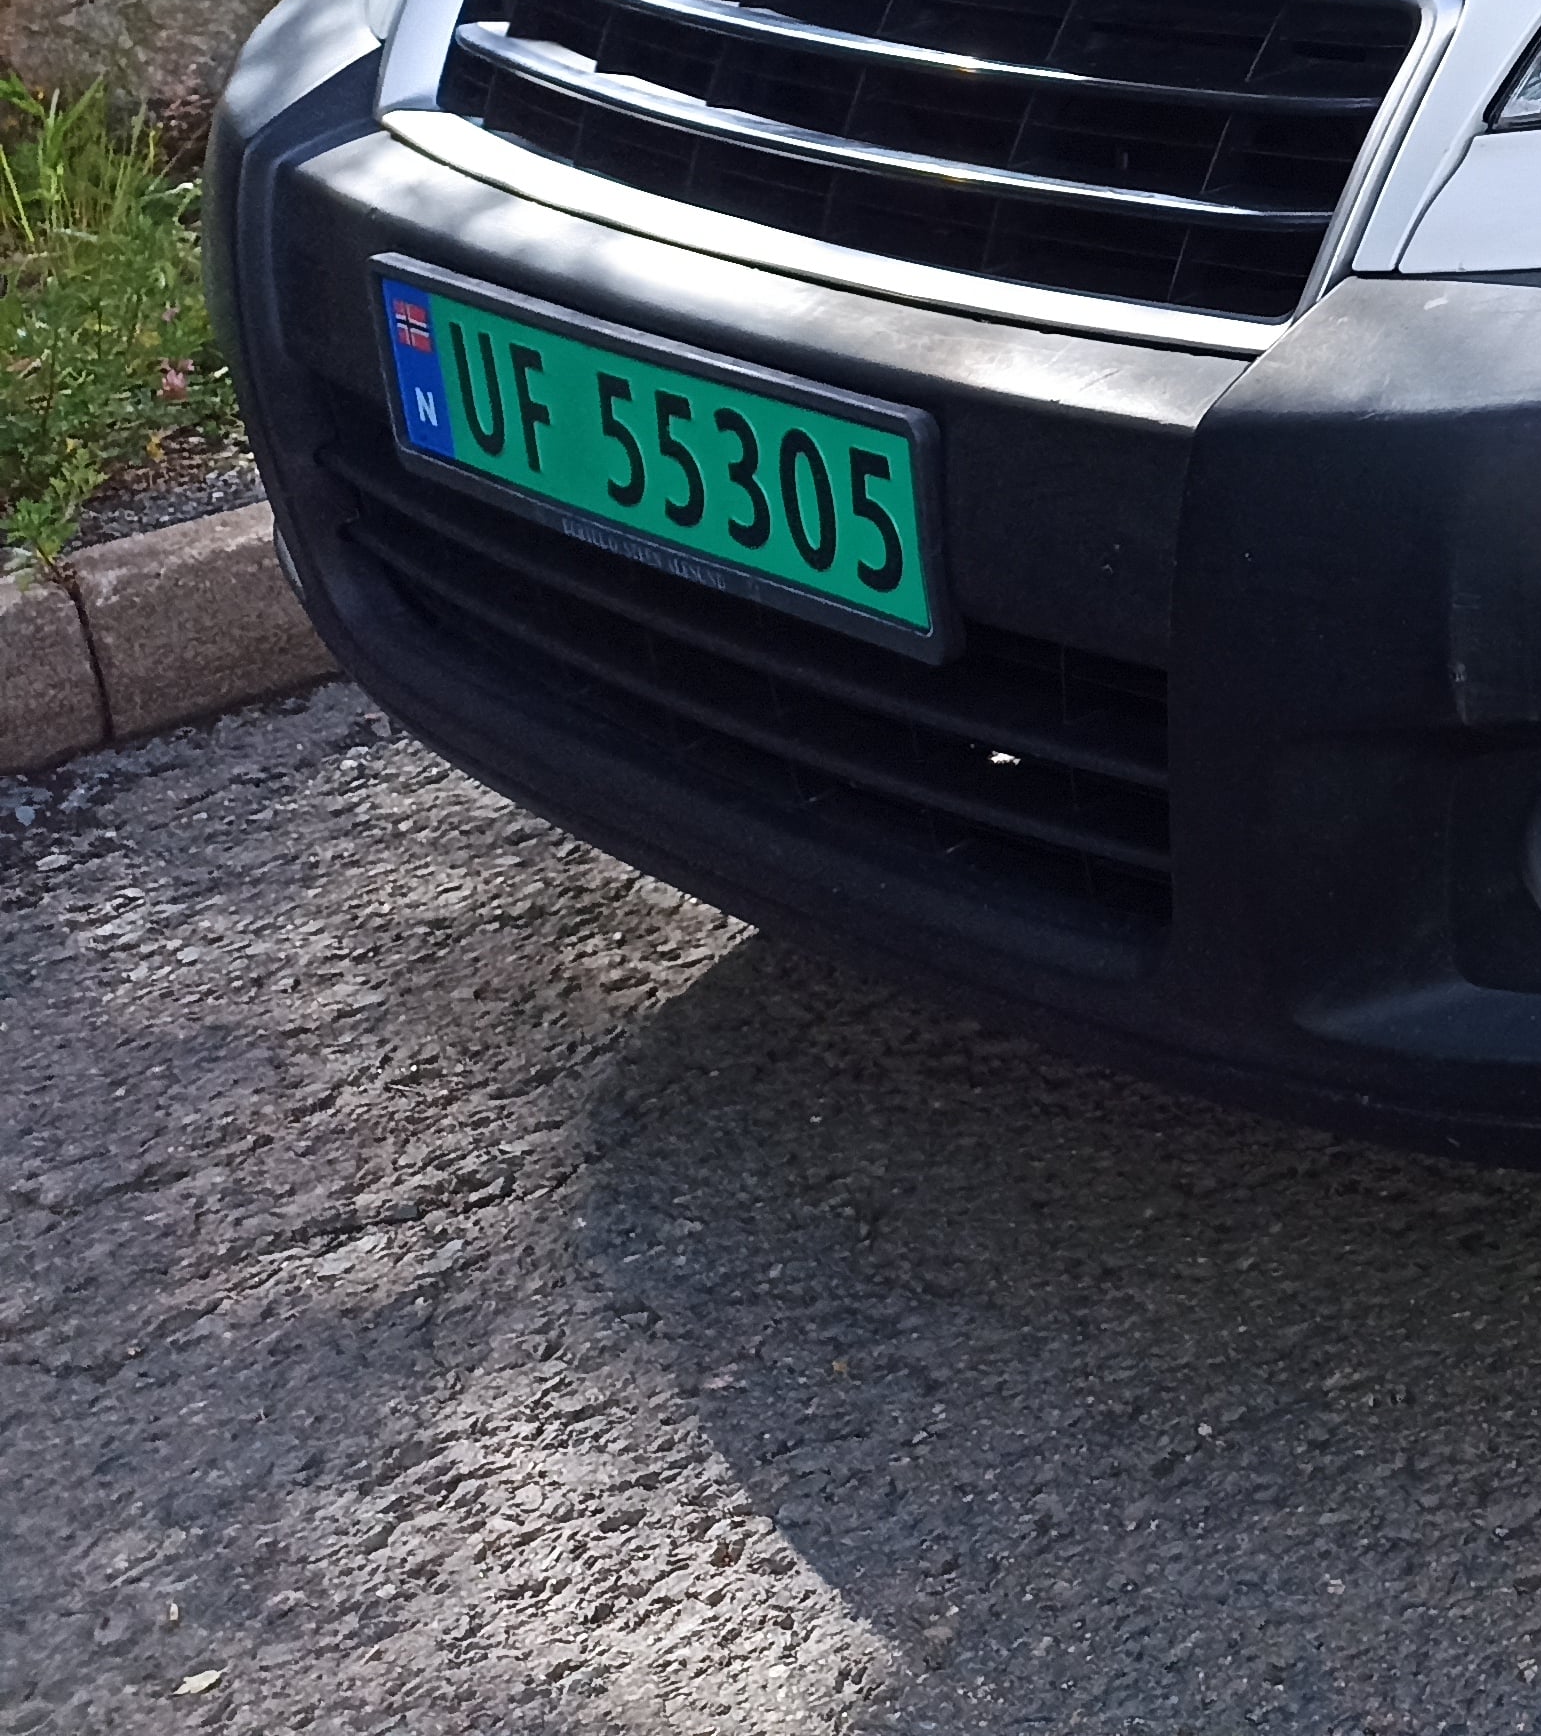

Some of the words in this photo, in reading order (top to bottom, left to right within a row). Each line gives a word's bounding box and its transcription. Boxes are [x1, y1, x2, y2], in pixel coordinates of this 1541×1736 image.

[414, 387, 439, 428] N
[448, 320, 552, 474] UF
[596, 369, 905, 594] 55305
